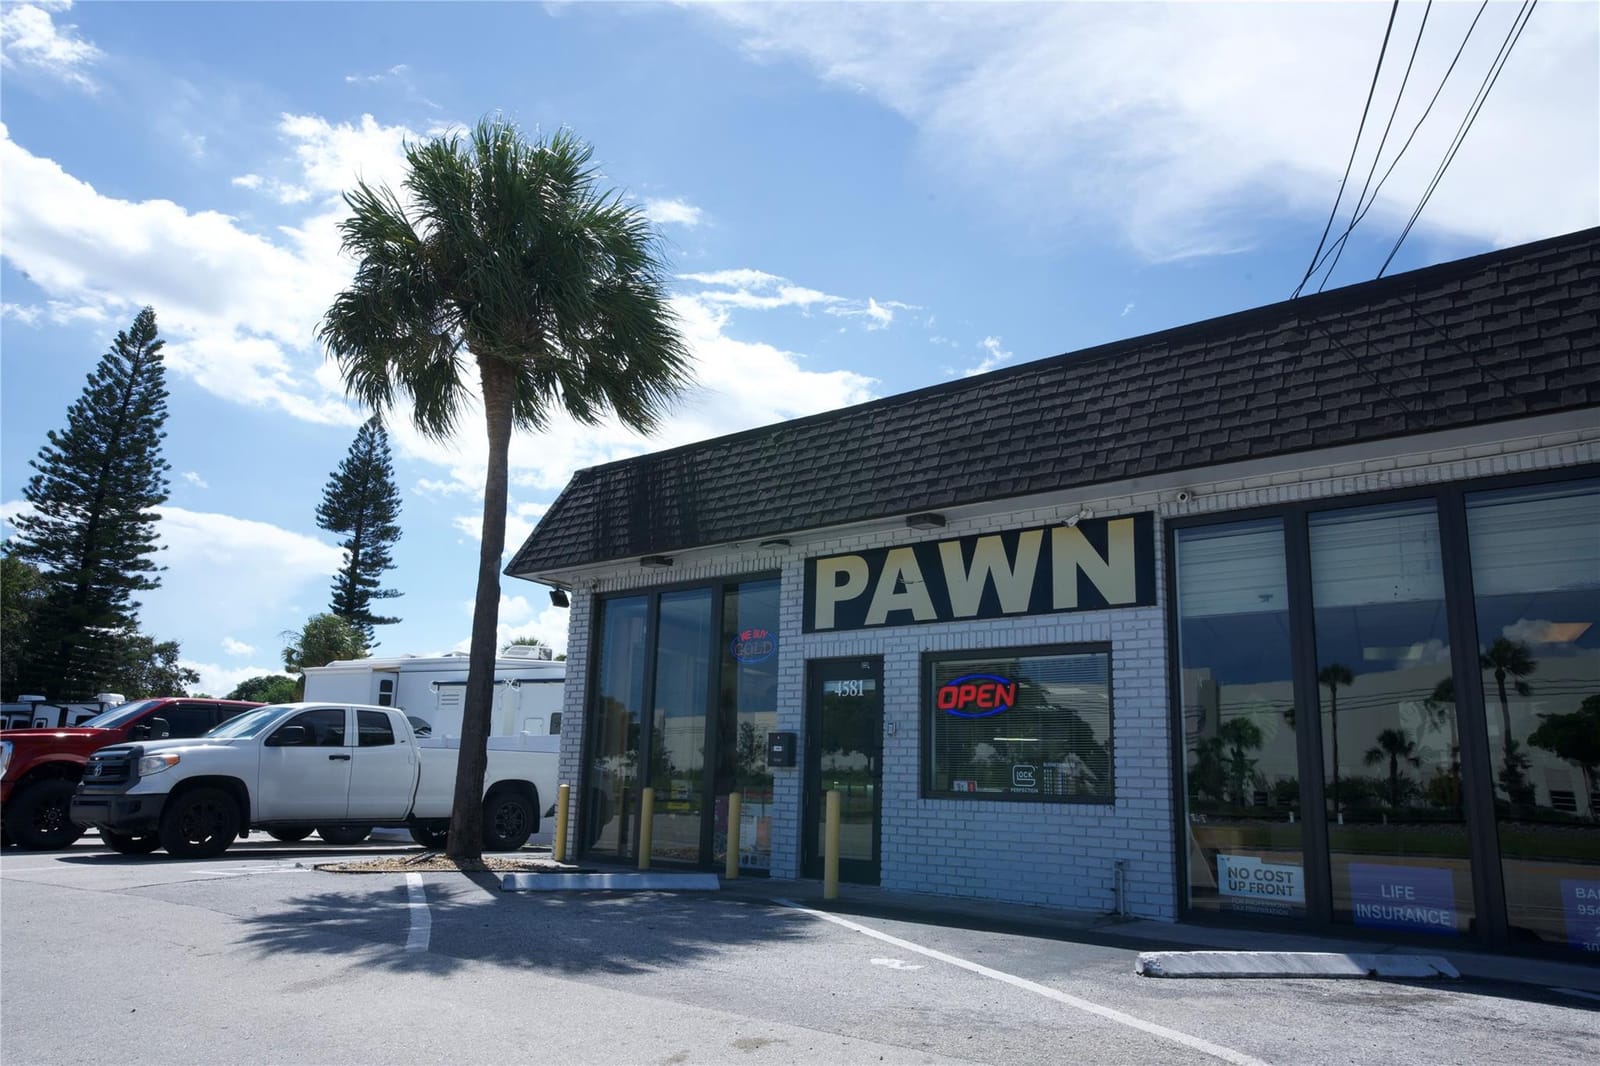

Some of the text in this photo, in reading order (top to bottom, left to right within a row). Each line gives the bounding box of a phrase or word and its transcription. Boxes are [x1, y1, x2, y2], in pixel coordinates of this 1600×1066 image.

[814, 518, 1137, 630] PAWN
[735, 642, 772, 656] GOLD
[834, 680, 865, 697] 4581
[937, 683, 1016, 710] OPEN
[1228, 867, 1294, 883] NO COST
[1228, 880, 1294, 896] UP FRONT
[1380, 884, 1416, 900] LIFE
[1575, 888, 1600, 901] BA
[1356, 904, 1451, 926] INSURANCE
